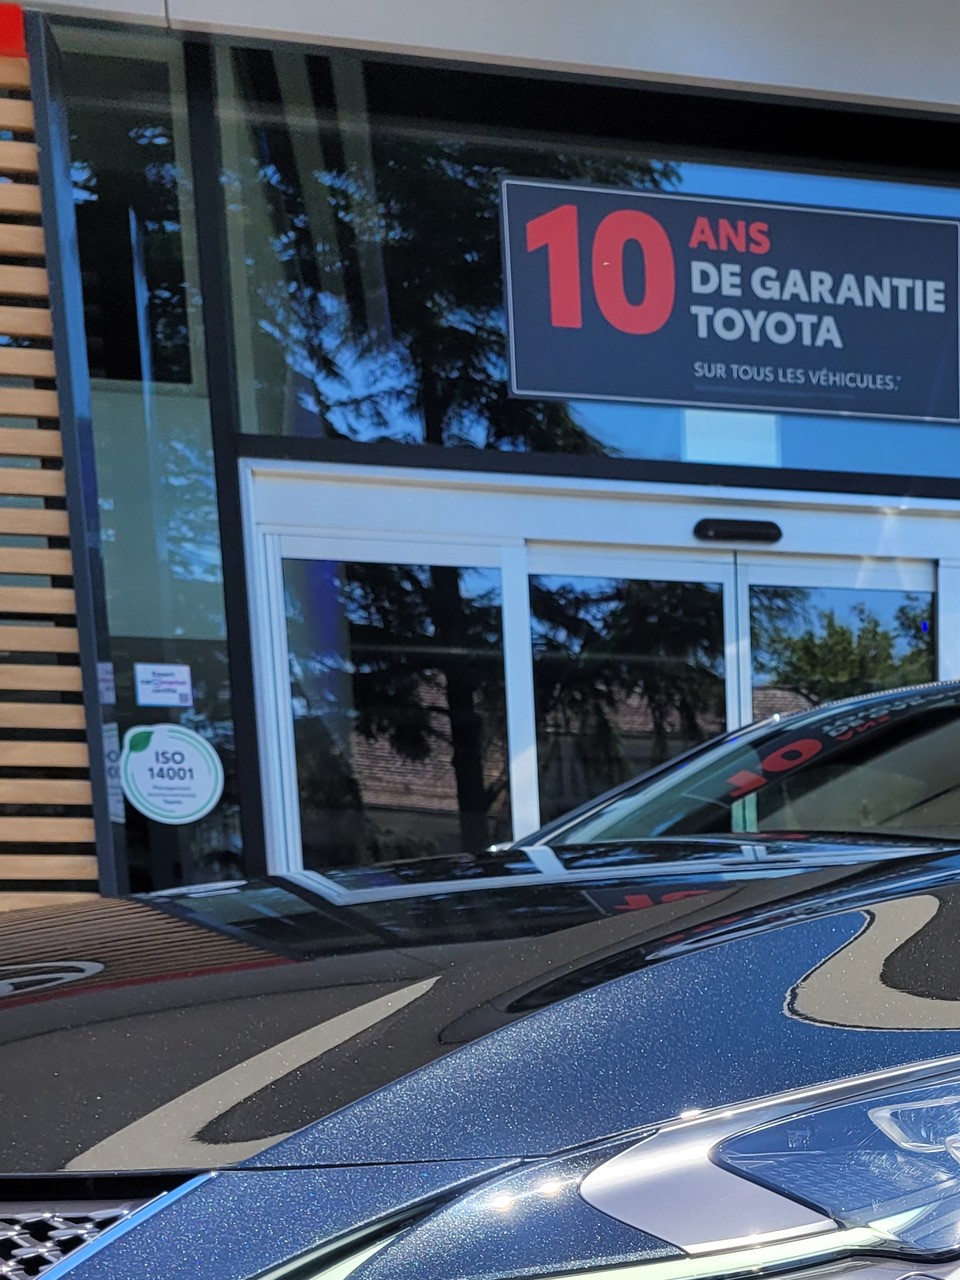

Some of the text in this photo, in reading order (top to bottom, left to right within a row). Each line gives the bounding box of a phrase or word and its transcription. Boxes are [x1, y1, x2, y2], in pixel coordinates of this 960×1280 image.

[689, 216, 771, 254] ANS
[526, 204, 675, 335] 10
[690, 260, 946, 313] DE GARANTIE
[690, 305, 843, 349] TOYOTA
[693, 361, 726, 379] SUR
[729, 364, 774, 382] TOUS
[778, 368, 805, 385] LES
[148, 766, 194, 781] 14001
[155, 750, 185, 765] ISO
